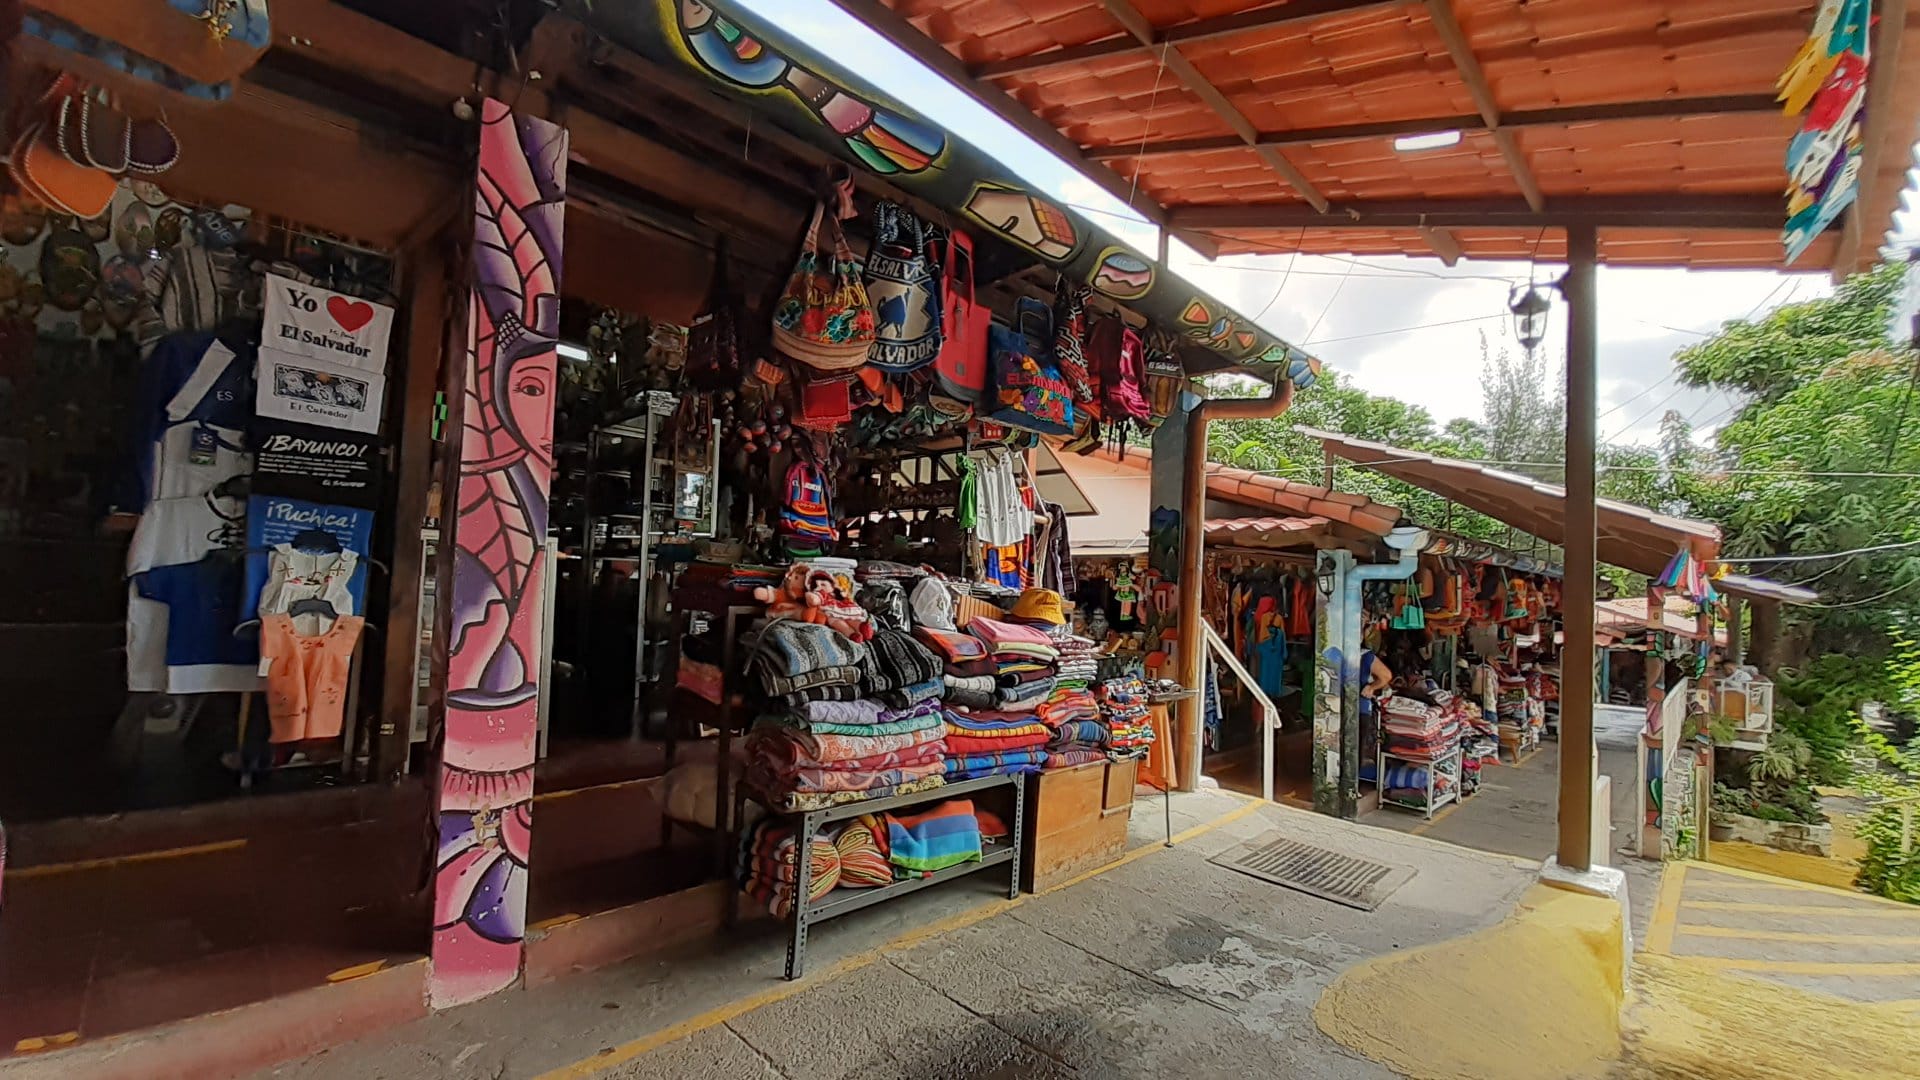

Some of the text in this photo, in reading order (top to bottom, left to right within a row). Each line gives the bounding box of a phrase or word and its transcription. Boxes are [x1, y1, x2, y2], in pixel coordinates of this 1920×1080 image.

[287, 287, 318, 313] Yo
[279, 323, 299, 341] El
[302, 330, 371, 358] Salvador
[216, 390, 234, 401] ES
[262, 434, 369, 458] ¡BAYUNCO!
